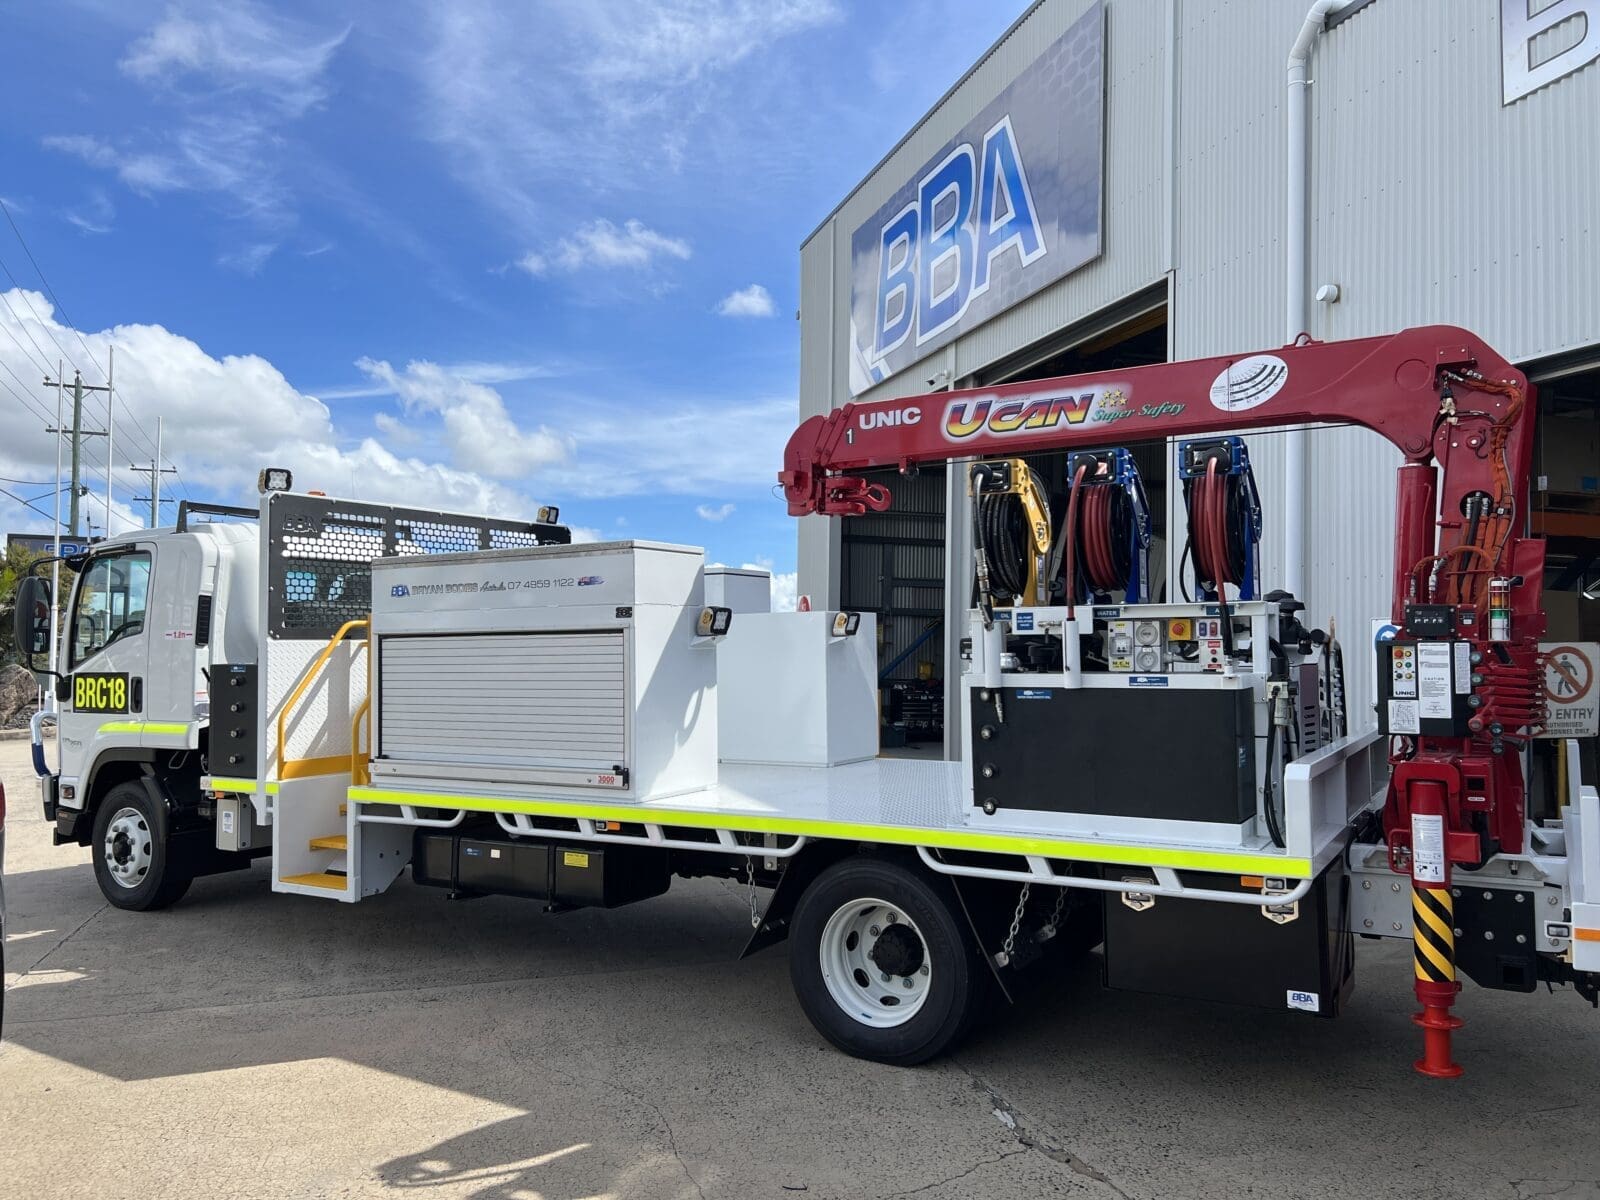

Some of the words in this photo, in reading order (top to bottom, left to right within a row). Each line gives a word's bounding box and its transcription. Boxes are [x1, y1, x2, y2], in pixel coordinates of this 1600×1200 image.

[871, 113, 1047, 366] BBA
[859, 407, 922, 430] UNIC
[945, 393, 1095, 437] UCAN
[1092, 409, 1135, 424] Super
[1138, 401, 1185, 418] Safety
[846, 429, 853, 444] 1
[391, 585, 410, 597] BBA
[508, 581, 521, 590] 07
[552, 578, 574, 587] 1122
[75, 677, 125, 709] BRC18
[1556, 707, 1595, 720] ENTRY
[1292, 993, 1313, 1003] BBA
